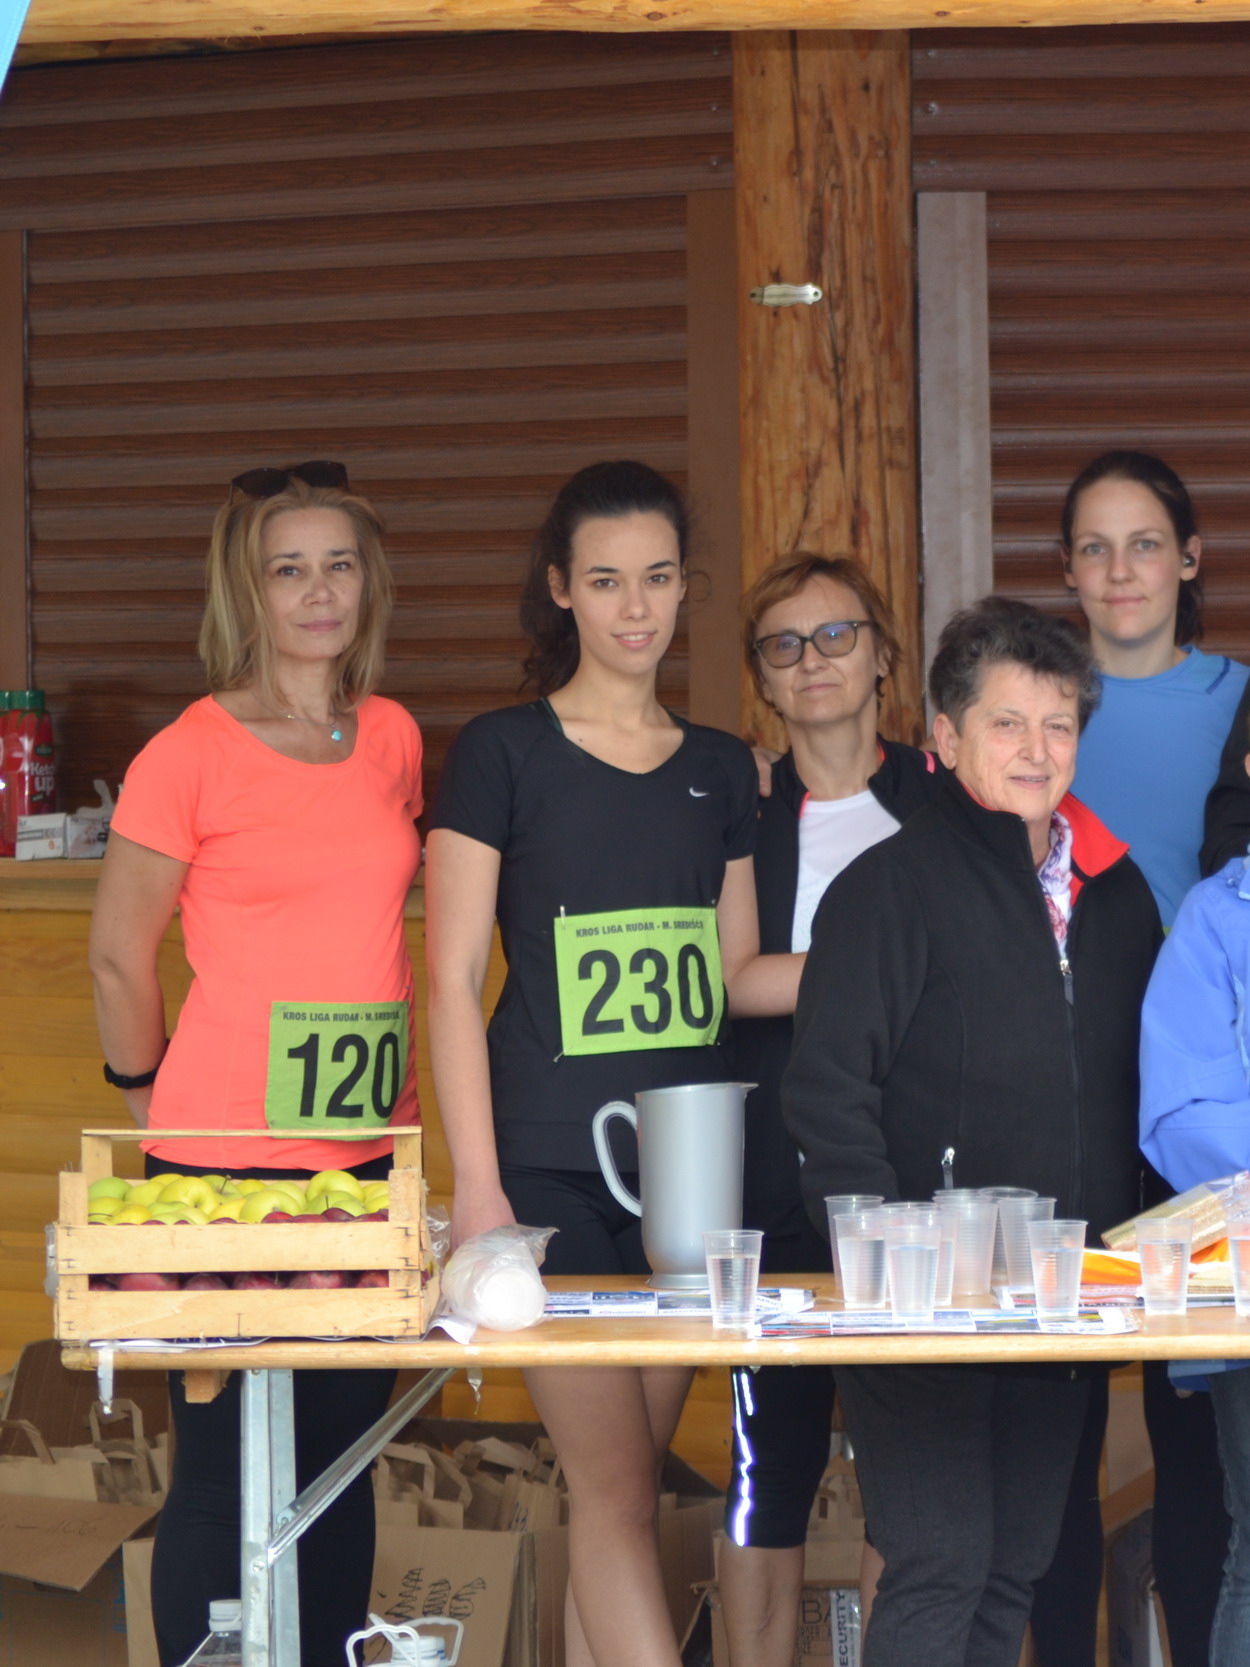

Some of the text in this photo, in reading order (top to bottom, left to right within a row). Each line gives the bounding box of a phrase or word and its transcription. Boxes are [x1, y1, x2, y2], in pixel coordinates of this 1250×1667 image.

[30, 762, 55, 776] Ketc
[34, 776, 55, 795] up
[575, 927, 600, 938] KROS
[602, 924, 623, 935] LIGA
[625, 921, 655, 932] RUDAR
[662, 920, 672, 930] M.
[578, 943, 714, 1037] 230
[282, 1011, 307, 1020] KROS
[309, 1012, 330, 1022] LIGA
[332, 1012, 359, 1022] RUDAR
[365, 1012, 373, 1021] M.
[287, 1032, 400, 1119] 120
[836, 1591, 849, 1667] ECURITY
